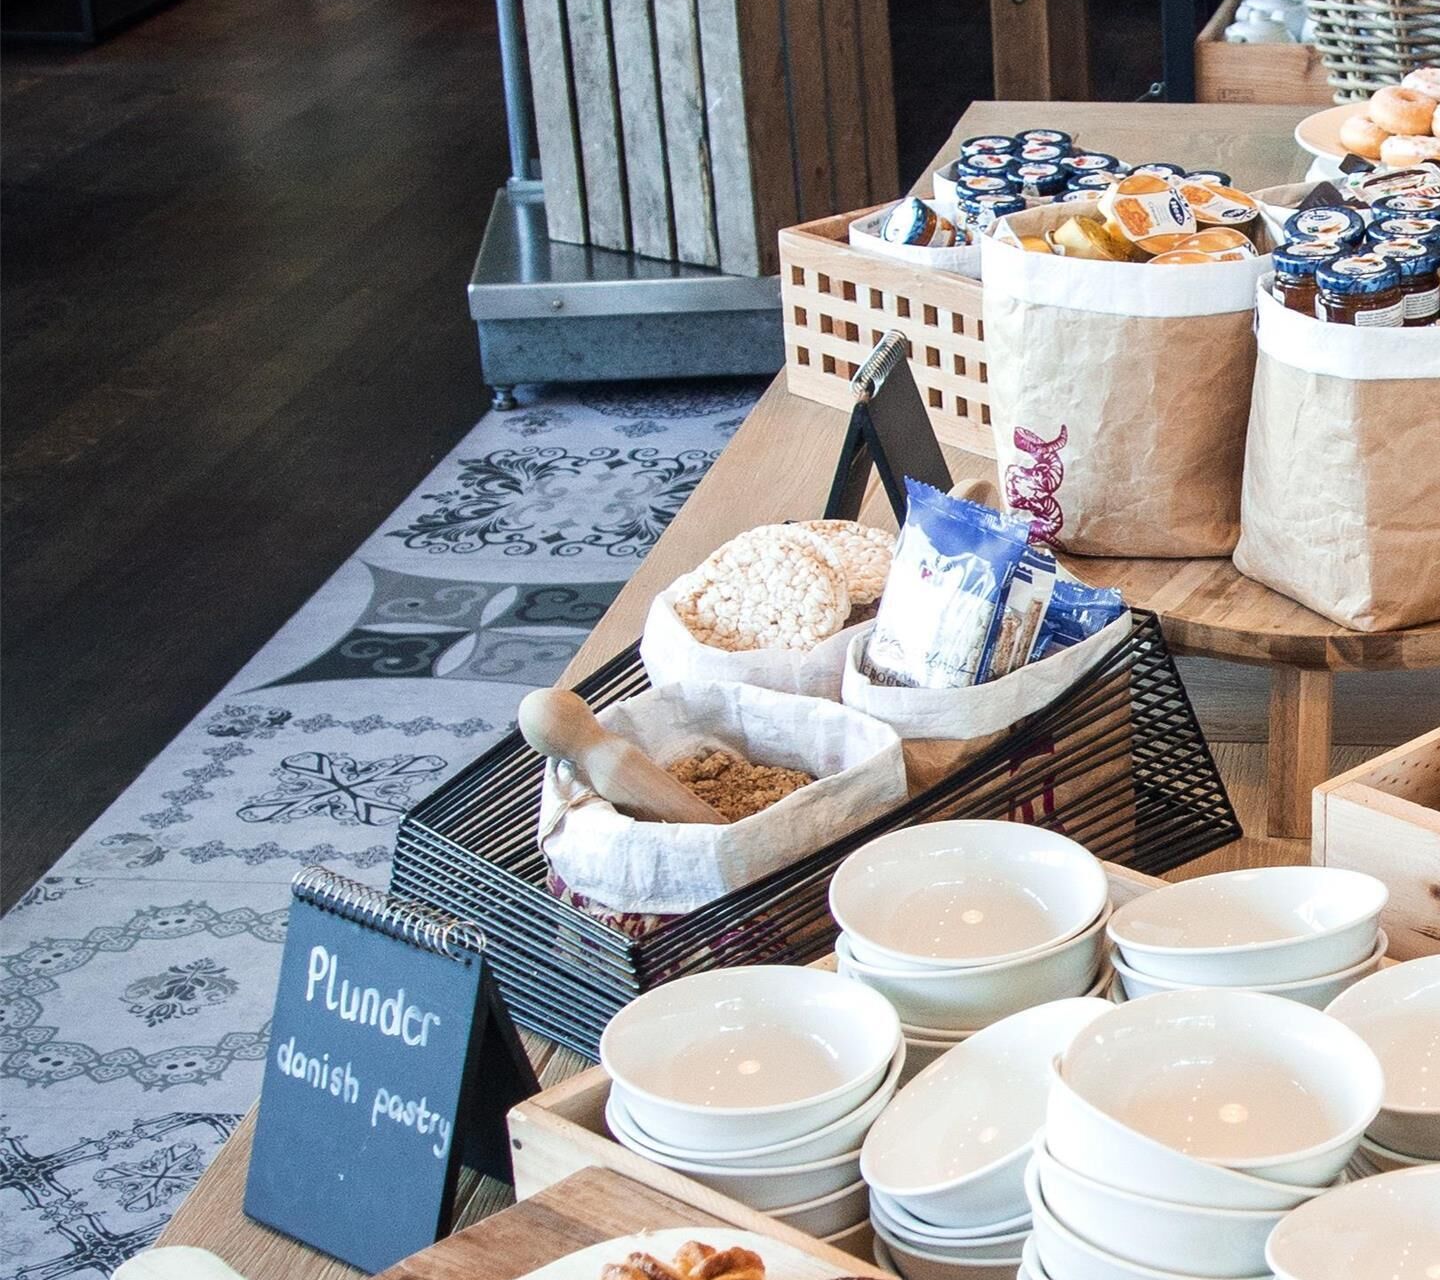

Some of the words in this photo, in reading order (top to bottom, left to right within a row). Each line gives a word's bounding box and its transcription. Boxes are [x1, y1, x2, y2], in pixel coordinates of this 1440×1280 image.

[305, 944, 441, 1048] Plunder
[276, 1036, 359, 1105] danish
[371, 1086, 453, 1160] pastry
